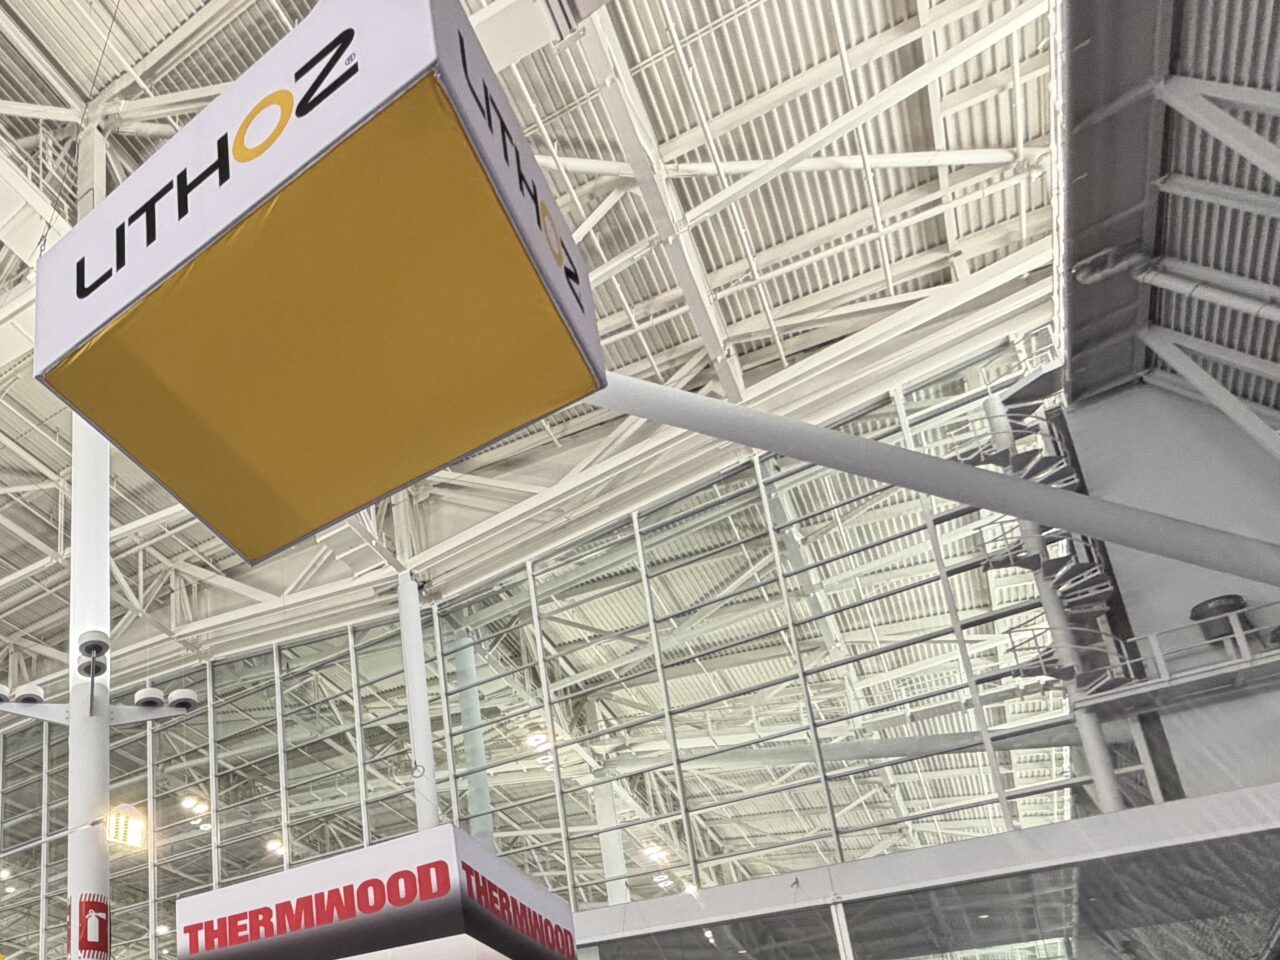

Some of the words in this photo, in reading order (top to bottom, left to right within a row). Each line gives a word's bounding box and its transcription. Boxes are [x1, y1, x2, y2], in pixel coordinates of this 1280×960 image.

[76, 28, 359, 299] LITHOZ
[457, 28, 586, 315] LITHOZ
[183, 860, 452, 956] THERMWOOD
[461, 861, 576, 960] THERMWOOD
